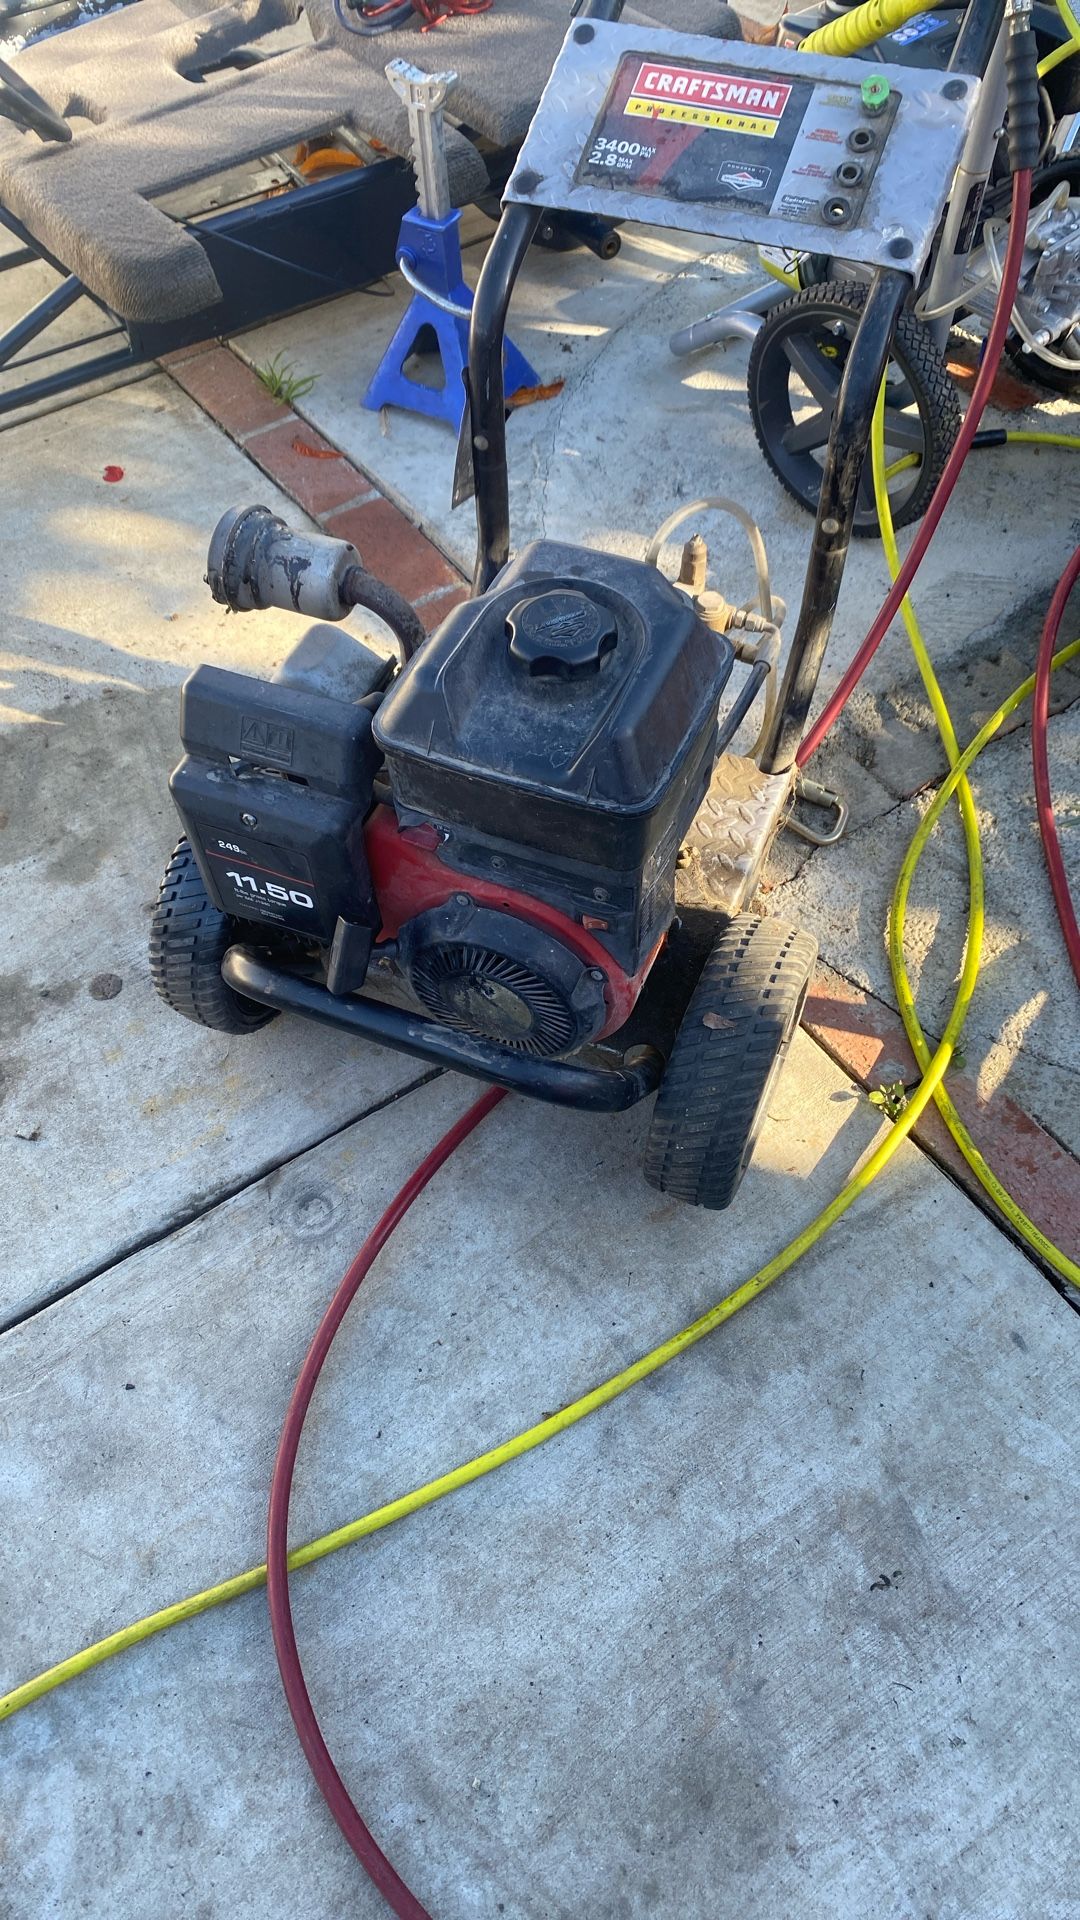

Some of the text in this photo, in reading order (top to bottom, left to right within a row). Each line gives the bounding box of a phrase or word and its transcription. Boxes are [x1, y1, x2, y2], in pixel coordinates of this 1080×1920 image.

[643, 71, 782, 109] CRAFTSMAN
[634, 104, 769, 131] PROFESSIONAL
[594, 138, 656, 156] 3400 MAX
[588, 151, 634, 167] 2.8 MAX
[616, 162, 632, 170] GPM
[225, 871, 314, 909] 11.50
